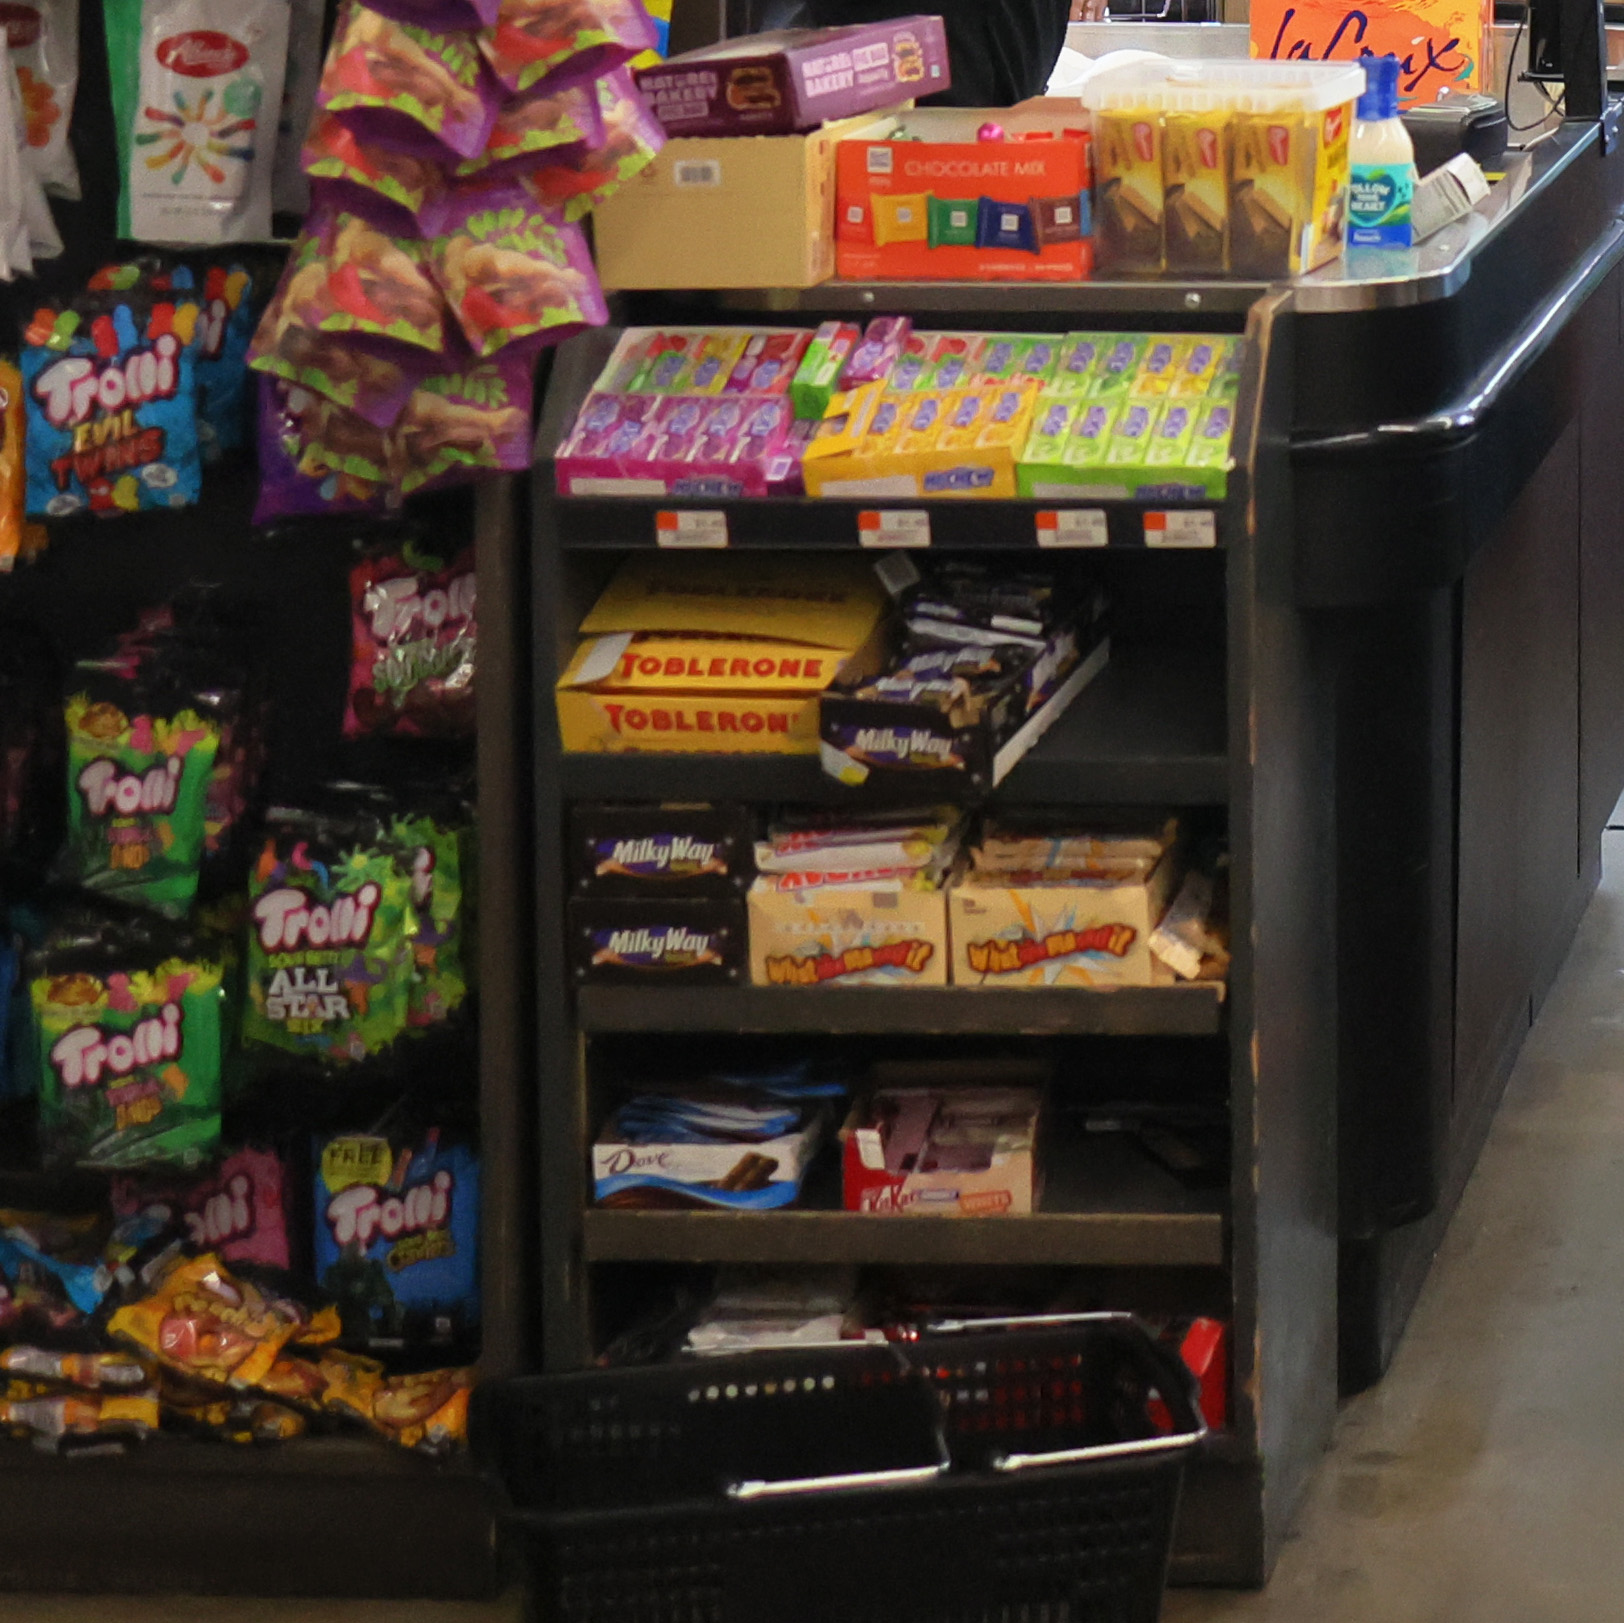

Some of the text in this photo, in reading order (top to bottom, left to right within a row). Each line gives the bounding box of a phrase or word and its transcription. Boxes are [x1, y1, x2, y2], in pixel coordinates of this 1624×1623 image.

[904, 160, 1009, 176] CHOCOLATE
[36, 332, 182, 424] Trolli
[364, 576, 477, 638] Troll
[621, 652, 824, 682] TOBLERONE
[604, 703, 800, 734] TOBLERON
[78, 757, 182, 816] Trolli
[612, 835, 715, 870] Milky Way
[255, 884, 382, 950] Trolli
[608, 926, 710, 959] Milky Way
[269, 967, 339, 996] ALL
[266, 993, 351, 1020] STAR
[50, 1004, 182, 1088] Trolli
[600, 1148, 670, 1175] Dove
[328, 1170, 452, 1245] Trolli
